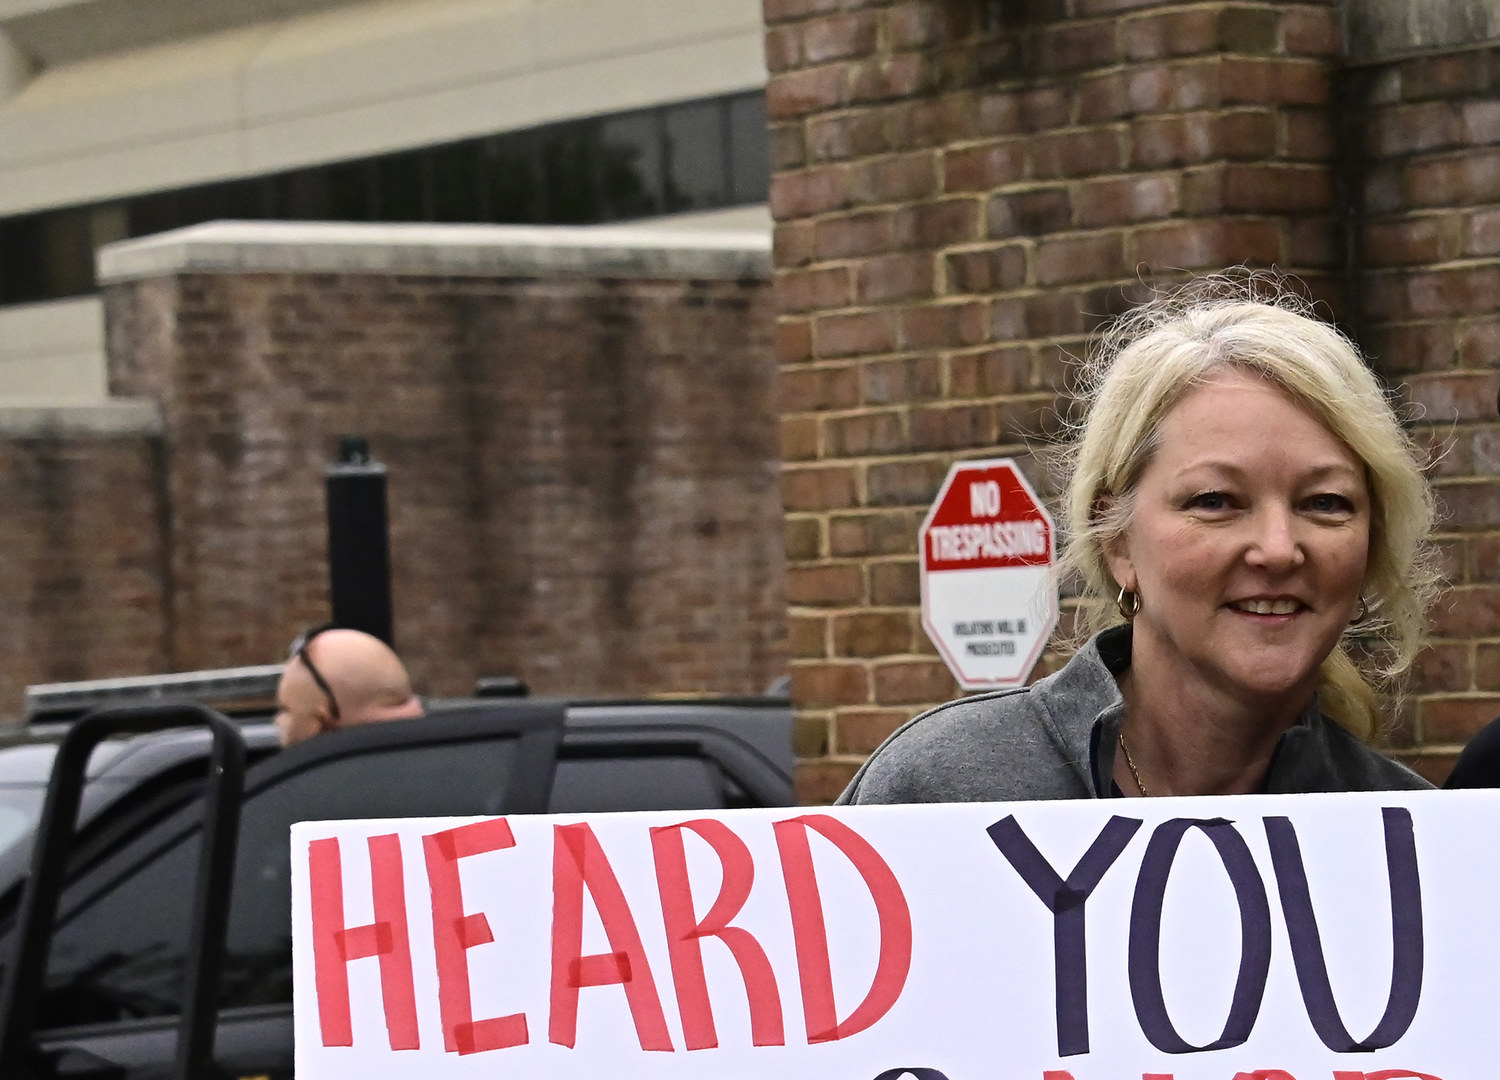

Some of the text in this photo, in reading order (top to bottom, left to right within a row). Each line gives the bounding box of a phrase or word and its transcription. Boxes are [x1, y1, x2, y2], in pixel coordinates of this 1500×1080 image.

[970, 481, 1000, 518] NO
[930, 520, 1045, 561] TRESPASSING
[308, 807, 1424, 1057] HEARD YOU
